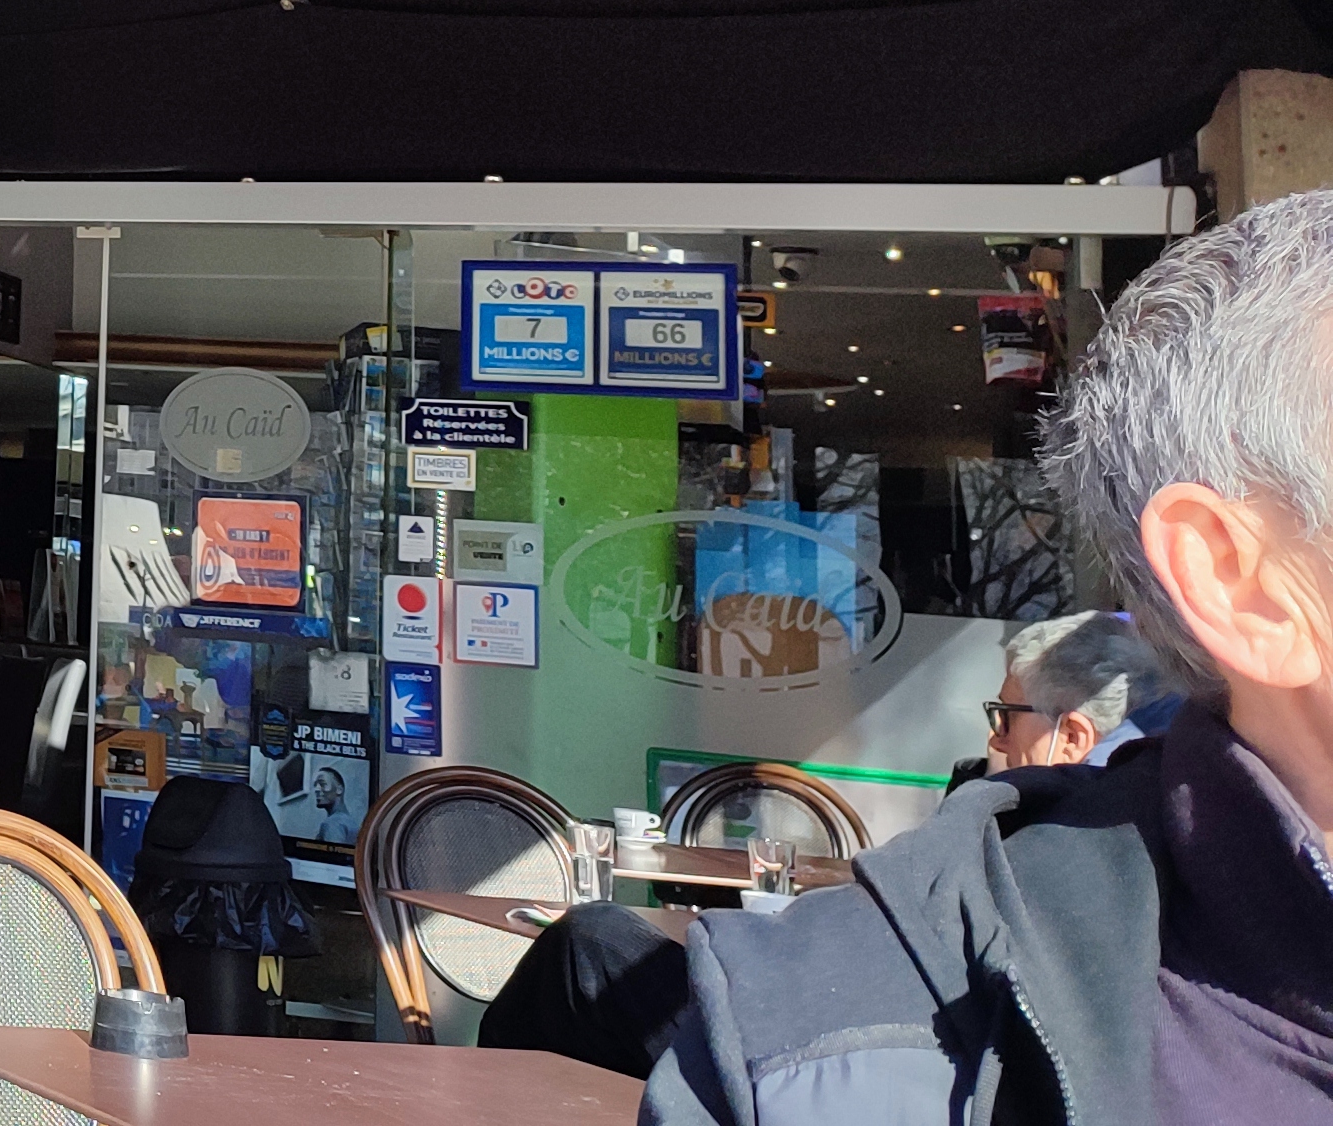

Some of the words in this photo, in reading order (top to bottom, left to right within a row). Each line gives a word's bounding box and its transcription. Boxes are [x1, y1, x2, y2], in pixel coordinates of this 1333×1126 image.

[511, 277, 578, 299] LOTO
[633, 290, 713, 300] EUROMILLIONS
[526, 318, 541, 338] 7
[652, 323, 686, 344] 66
[484, 346, 563, 361] MILLIONS
[564, 349, 580, 361] €
[614, 351, 698, 366] MILLIONS
[701, 353, 714, 366] €
[420, 406, 509, 418] TOILETTES
[175, 406, 217, 438] Au
[226, 404, 292, 439] Caïd
[423, 418, 506, 431] Réservées
[413, 429, 423, 440] à
[427, 430, 441, 440] la
[445, 431, 516, 444] clientèle
[417, 456, 467, 469] TIMBRES
[417, 469, 428, 477] EN
[429, 469, 453, 478] VENTE
[613, 566, 688, 624] Au
[396, 623, 428, 634] Ticket
[294, 724, 311, 739] JP
[313, 726, 362, 745] BIMENI
[301, 741, 316, 752] THE
[317, 742, 341, 754] BLACK
[342, 745, 367, 757] BELTS
